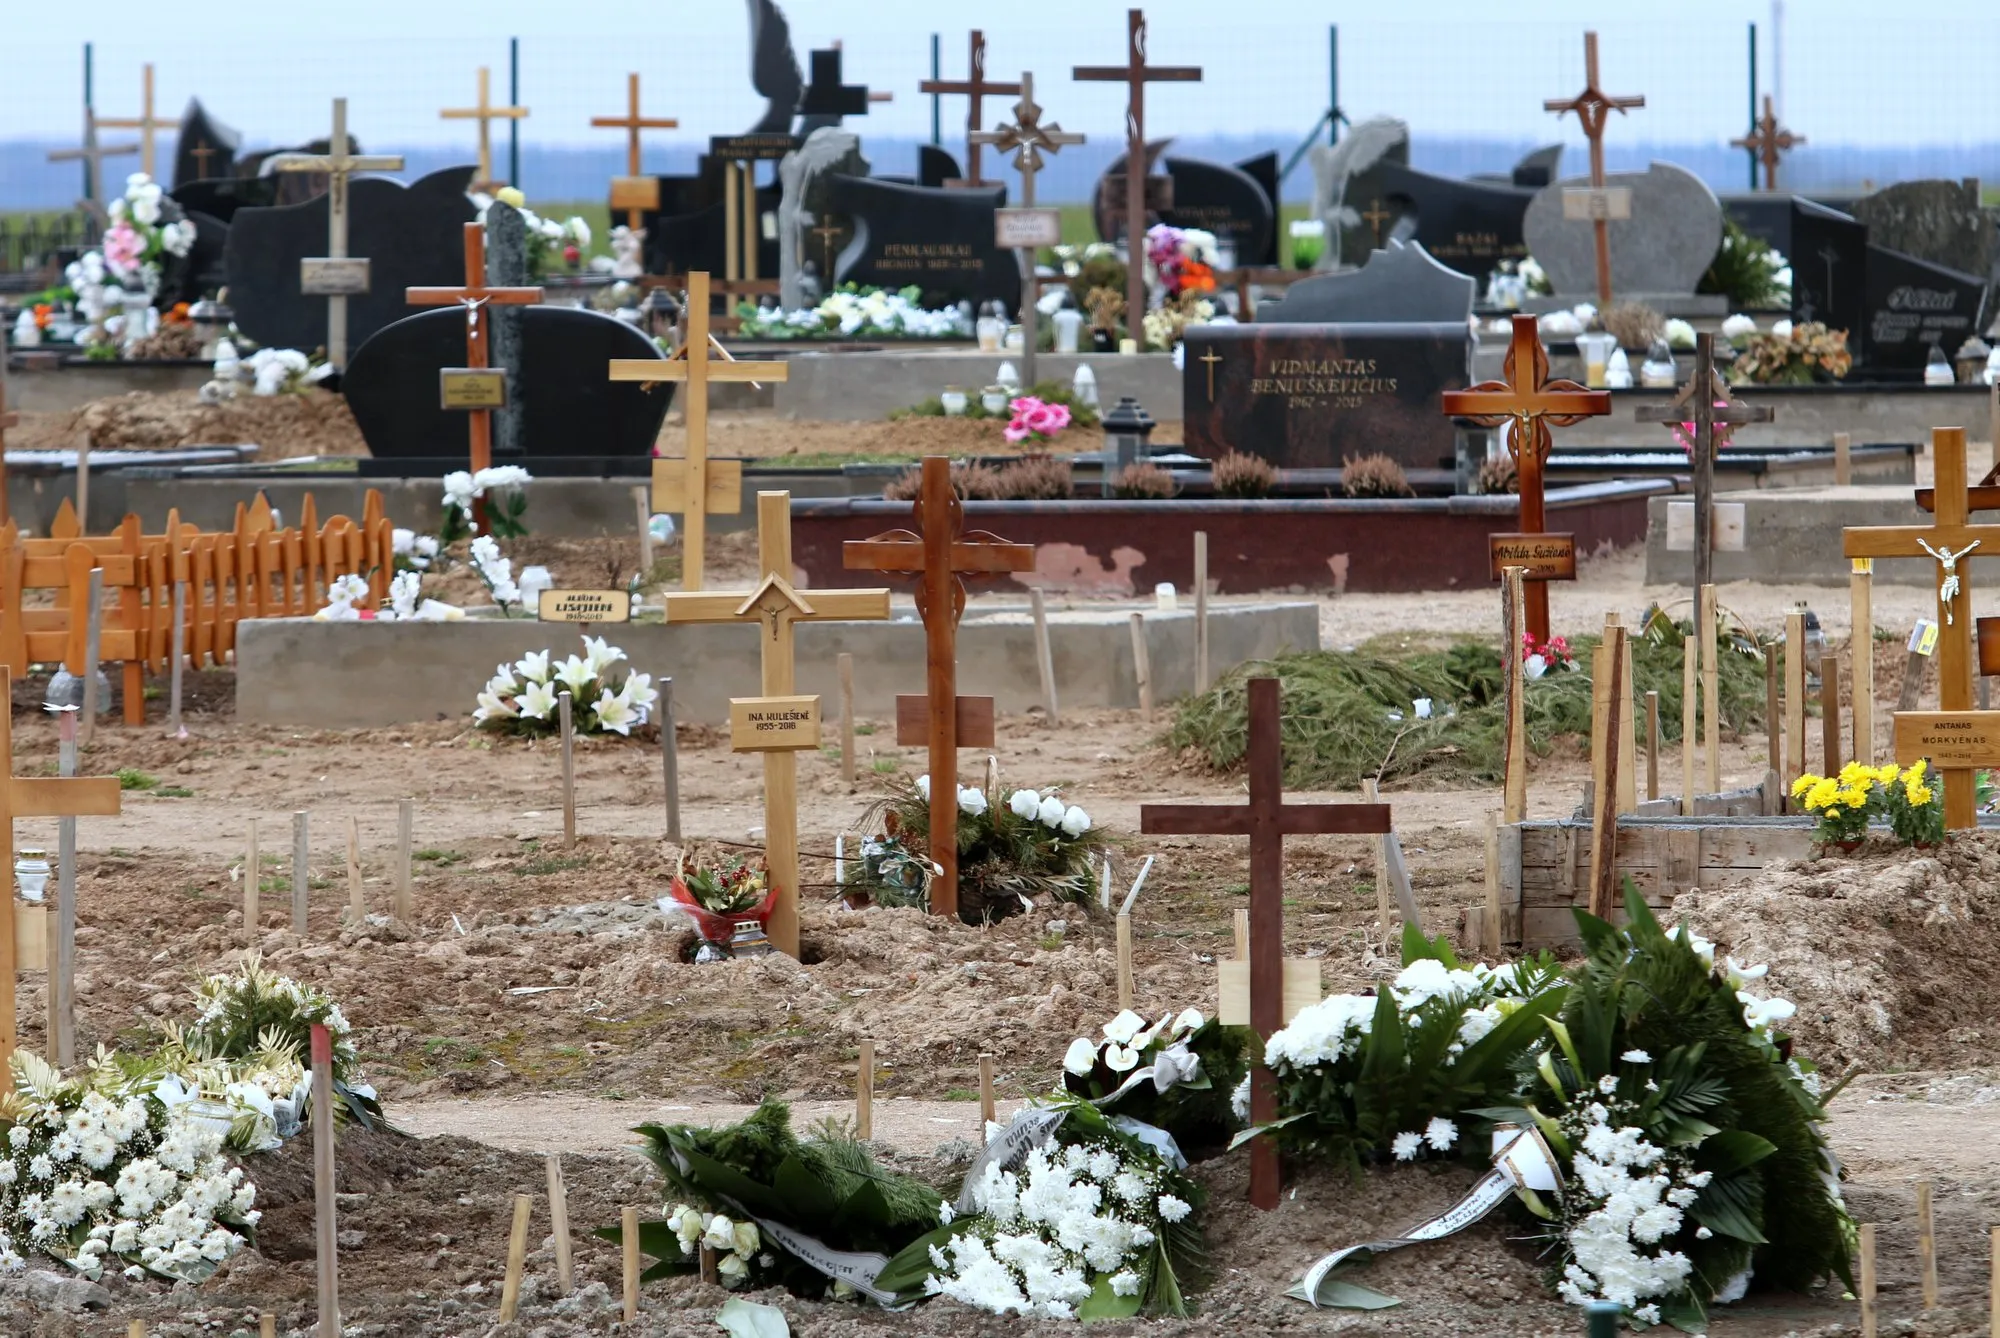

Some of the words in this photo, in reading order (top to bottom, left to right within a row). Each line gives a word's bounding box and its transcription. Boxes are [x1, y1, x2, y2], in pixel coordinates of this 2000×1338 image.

[1270, 359, 1377, 375] VIDMANTAS
[1251, 376, 1398, 394] BENIUŠKEVIČIUS
[748, 713, 764, 721] INA
[756, 722, 796, 731] 1955-2016
